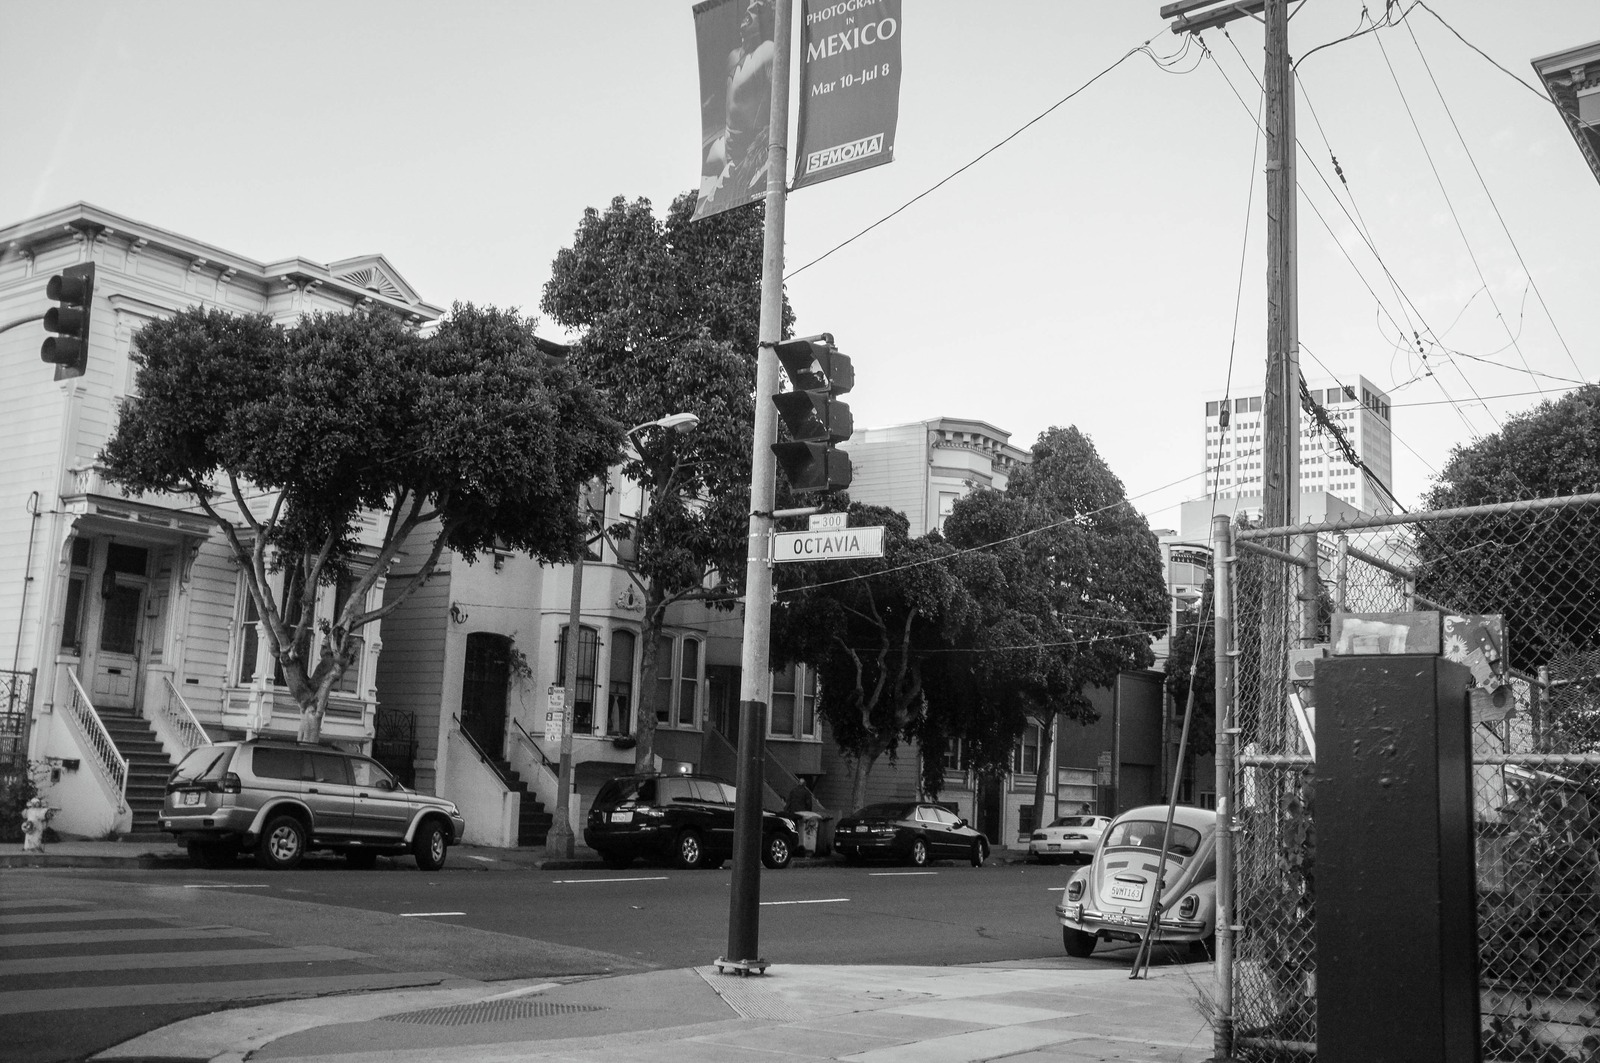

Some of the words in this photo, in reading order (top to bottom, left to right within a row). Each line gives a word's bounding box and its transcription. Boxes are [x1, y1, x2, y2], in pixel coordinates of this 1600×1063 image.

[807, 0, 883, 26] PHOTOGRA
[846, 16, 855, 25] IN
[806, 17, 897, 63] MEXICO
[811, 81, 837, 97] Mar
[881, 63, 890, 77] 8
[810, 137, 879, 169] SFMOMA
[822, 516, 841, 527] 300
[793, 535, 860, 554] OCTAVIA
